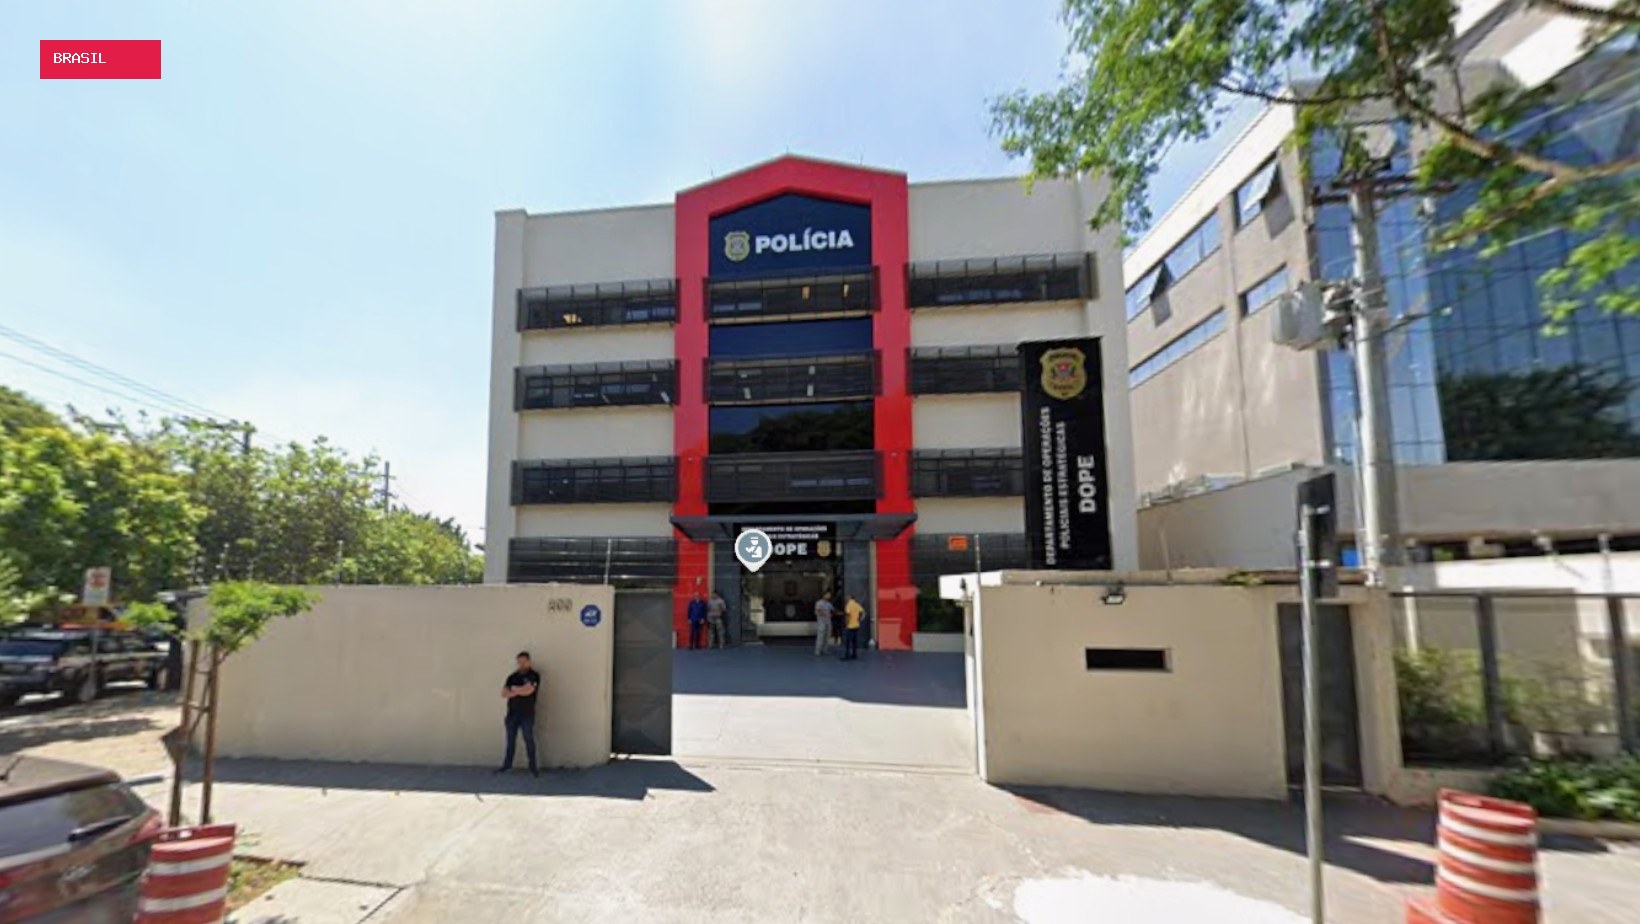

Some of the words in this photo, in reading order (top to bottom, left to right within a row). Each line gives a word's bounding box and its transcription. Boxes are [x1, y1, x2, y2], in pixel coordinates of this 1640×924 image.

[755, 227, 854, 254] POLÍCIA
[1040, 406, 1053, 468] OPERAÇÕES
[1055, 421, 1068, 496] ESTRATÉGICAS
[1042, 469, 1053, 482] DE
[1077, 454, 1096, 513] DOPE
[774, 542, 808, 555] OPE
[1043, 484, 1056, 565] DEPARTAMENTO
[1058, 498, 1070, 549] POLICIAIS
